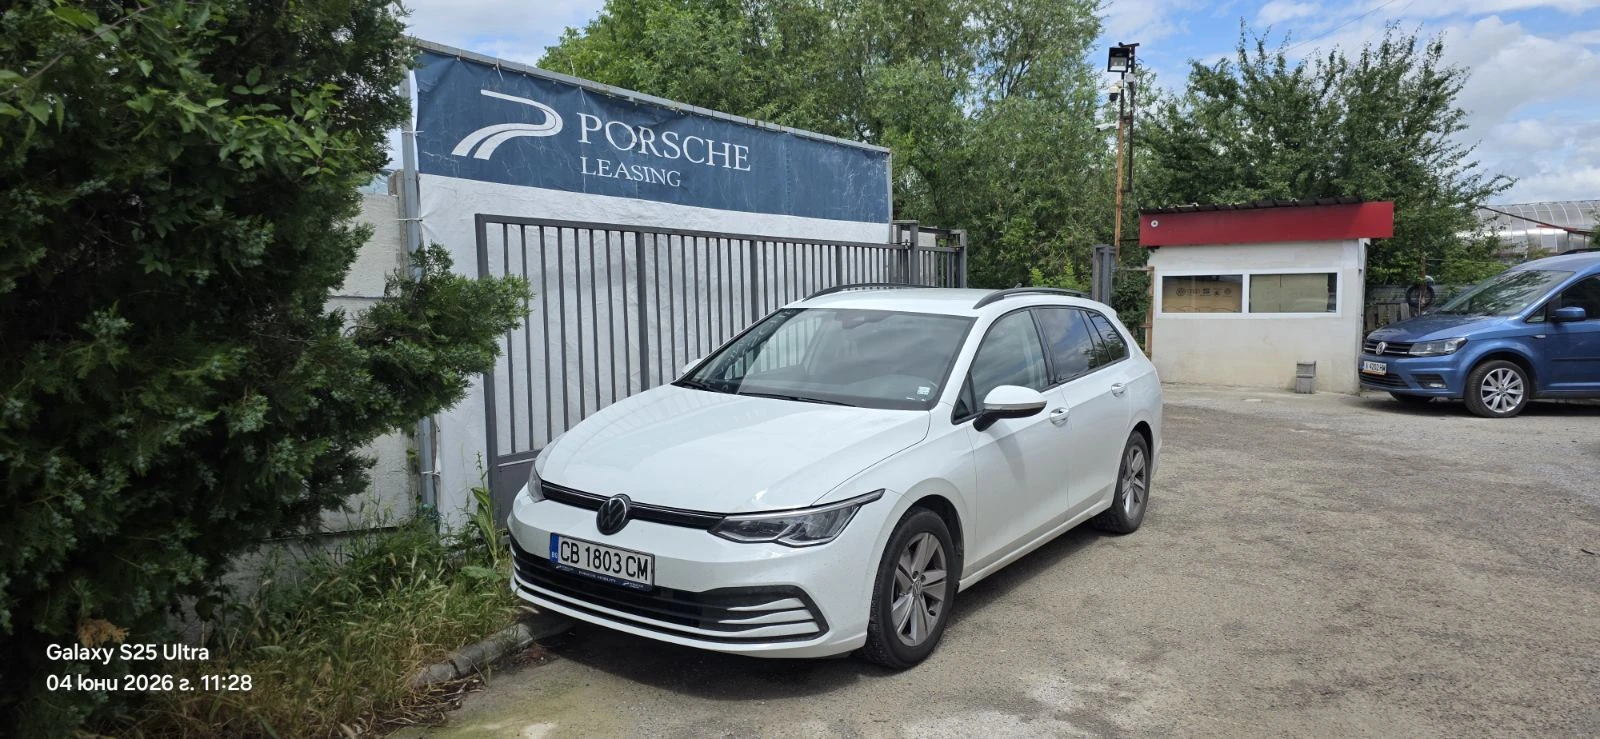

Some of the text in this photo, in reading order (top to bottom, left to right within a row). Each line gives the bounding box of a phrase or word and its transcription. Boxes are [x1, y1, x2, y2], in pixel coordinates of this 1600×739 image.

[576, 112, 751, 172] PORSCHE
[580, 156, 682, 187] LEASING
[560, 541, 648, 581] CB 1803 CM
